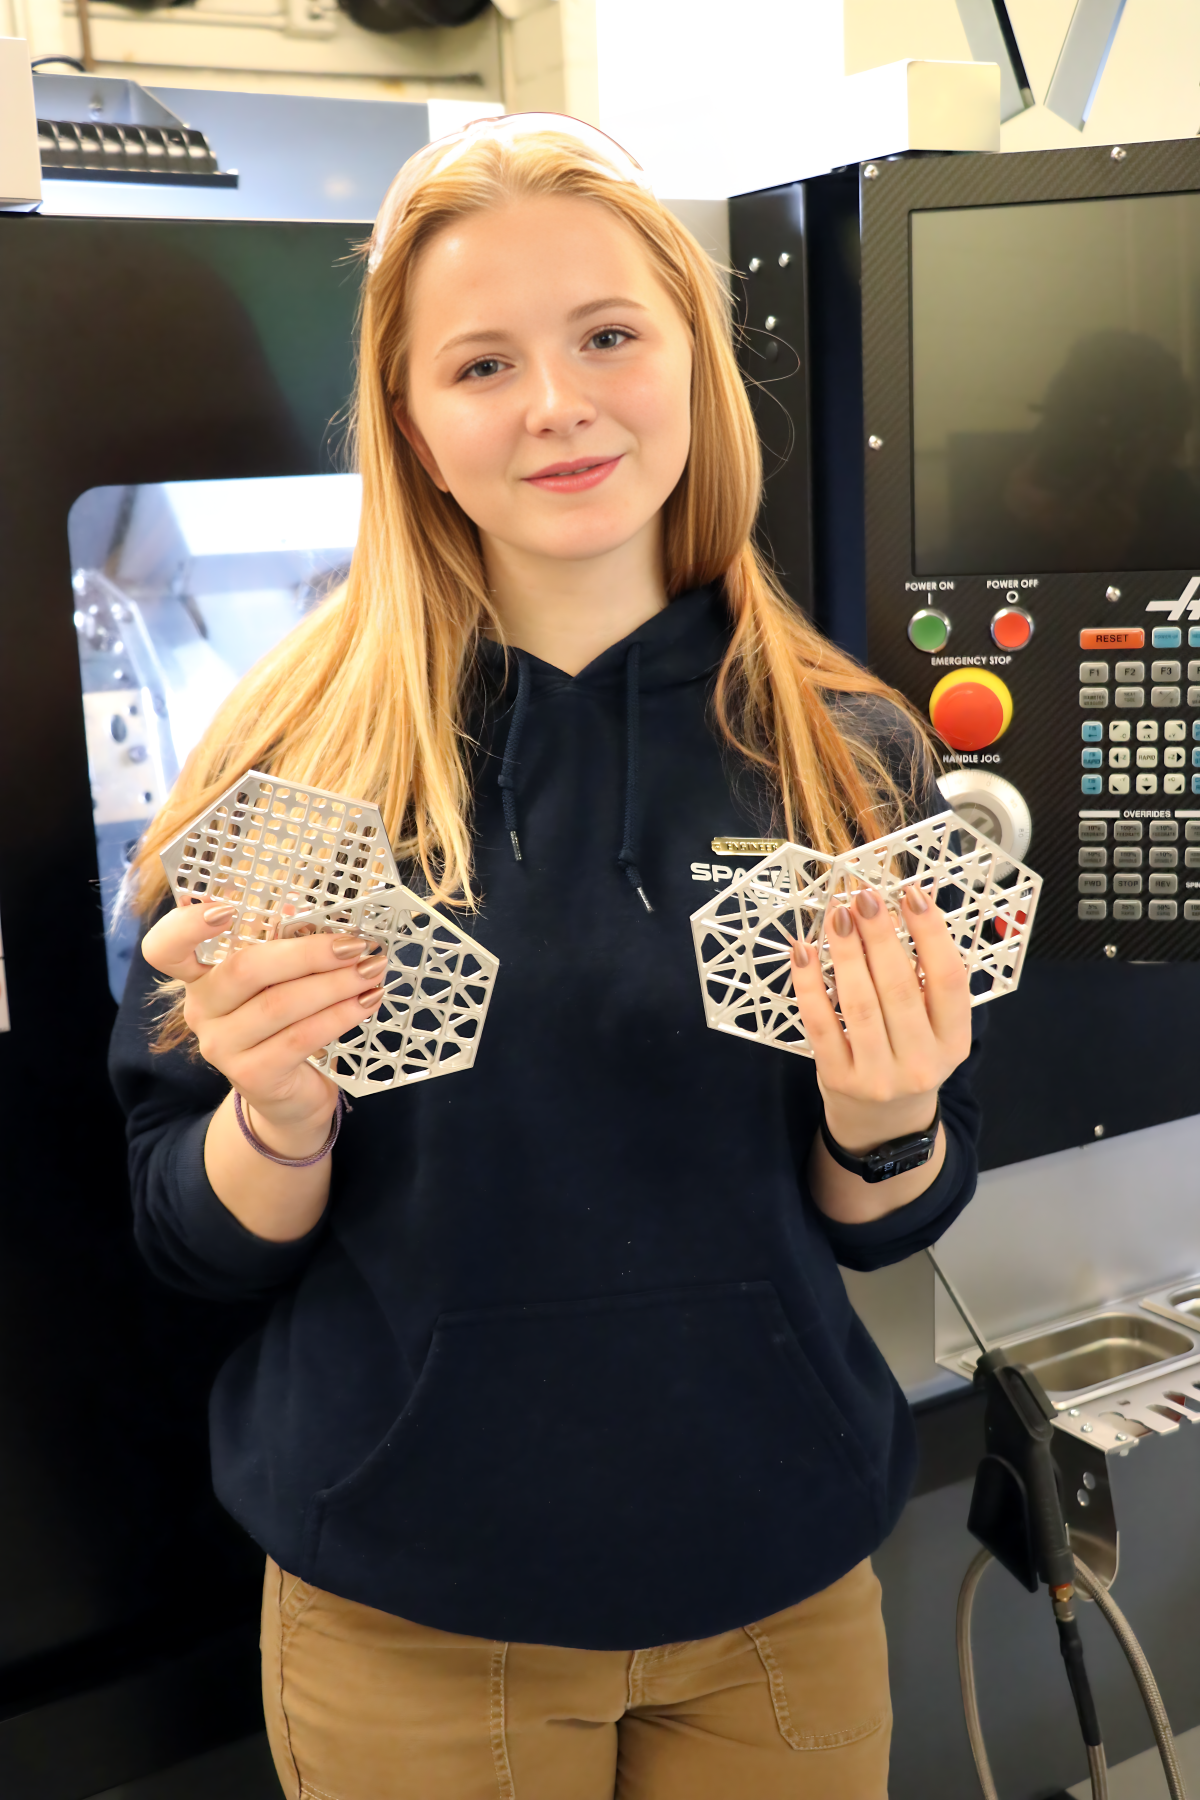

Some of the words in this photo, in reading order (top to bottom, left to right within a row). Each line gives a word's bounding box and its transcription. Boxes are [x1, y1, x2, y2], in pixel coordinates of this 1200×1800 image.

[905, 582, 937, 591] POWER
[938, 581, 954, 590] ON
[986, 580, 1019, 589] POWER
[1020, 579, 1039, 588] OFF
[1095, 634, 1129, 643] RESET
[930, 656, 987, 666] EMERGENCY
[989, 655, 1012, 665] STOP
[1089, 668, 1100, 677] F1
[1124, 667, 1136, 676] F2
[1160, 666, 1172, 675] F3
[942, 754, 978, 764] HANDLE
[980, 754, 1001, 764] JOG
[1123, 810, 1171, 818] OVERRIDES
